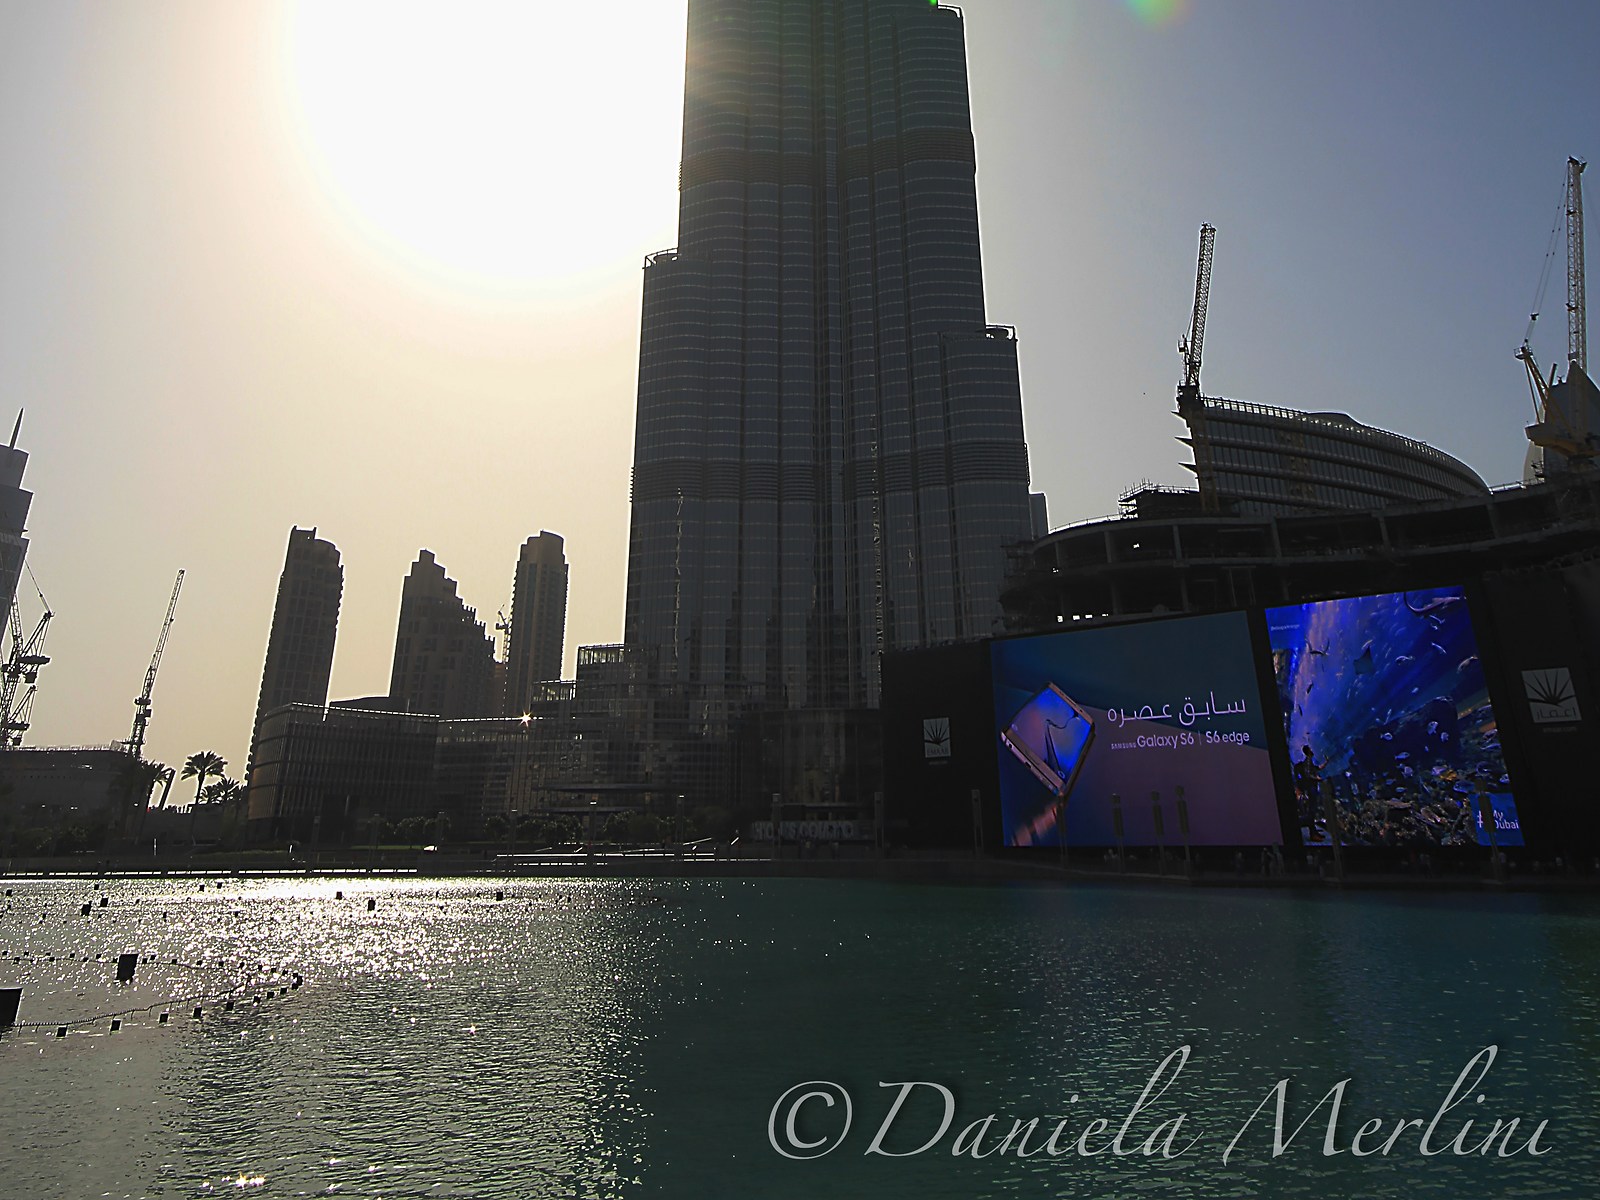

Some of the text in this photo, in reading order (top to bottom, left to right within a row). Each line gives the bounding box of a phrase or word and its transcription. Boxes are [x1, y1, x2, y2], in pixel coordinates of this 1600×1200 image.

[1107, 691, 1246, 727] سابق عصره
[1136, 734, 1178, 749] Galaxy
[1180, 732, 1195, 745] S6
[1205, 730, 1220, 744] S6
[1222, 731, 1250, 746] edge
